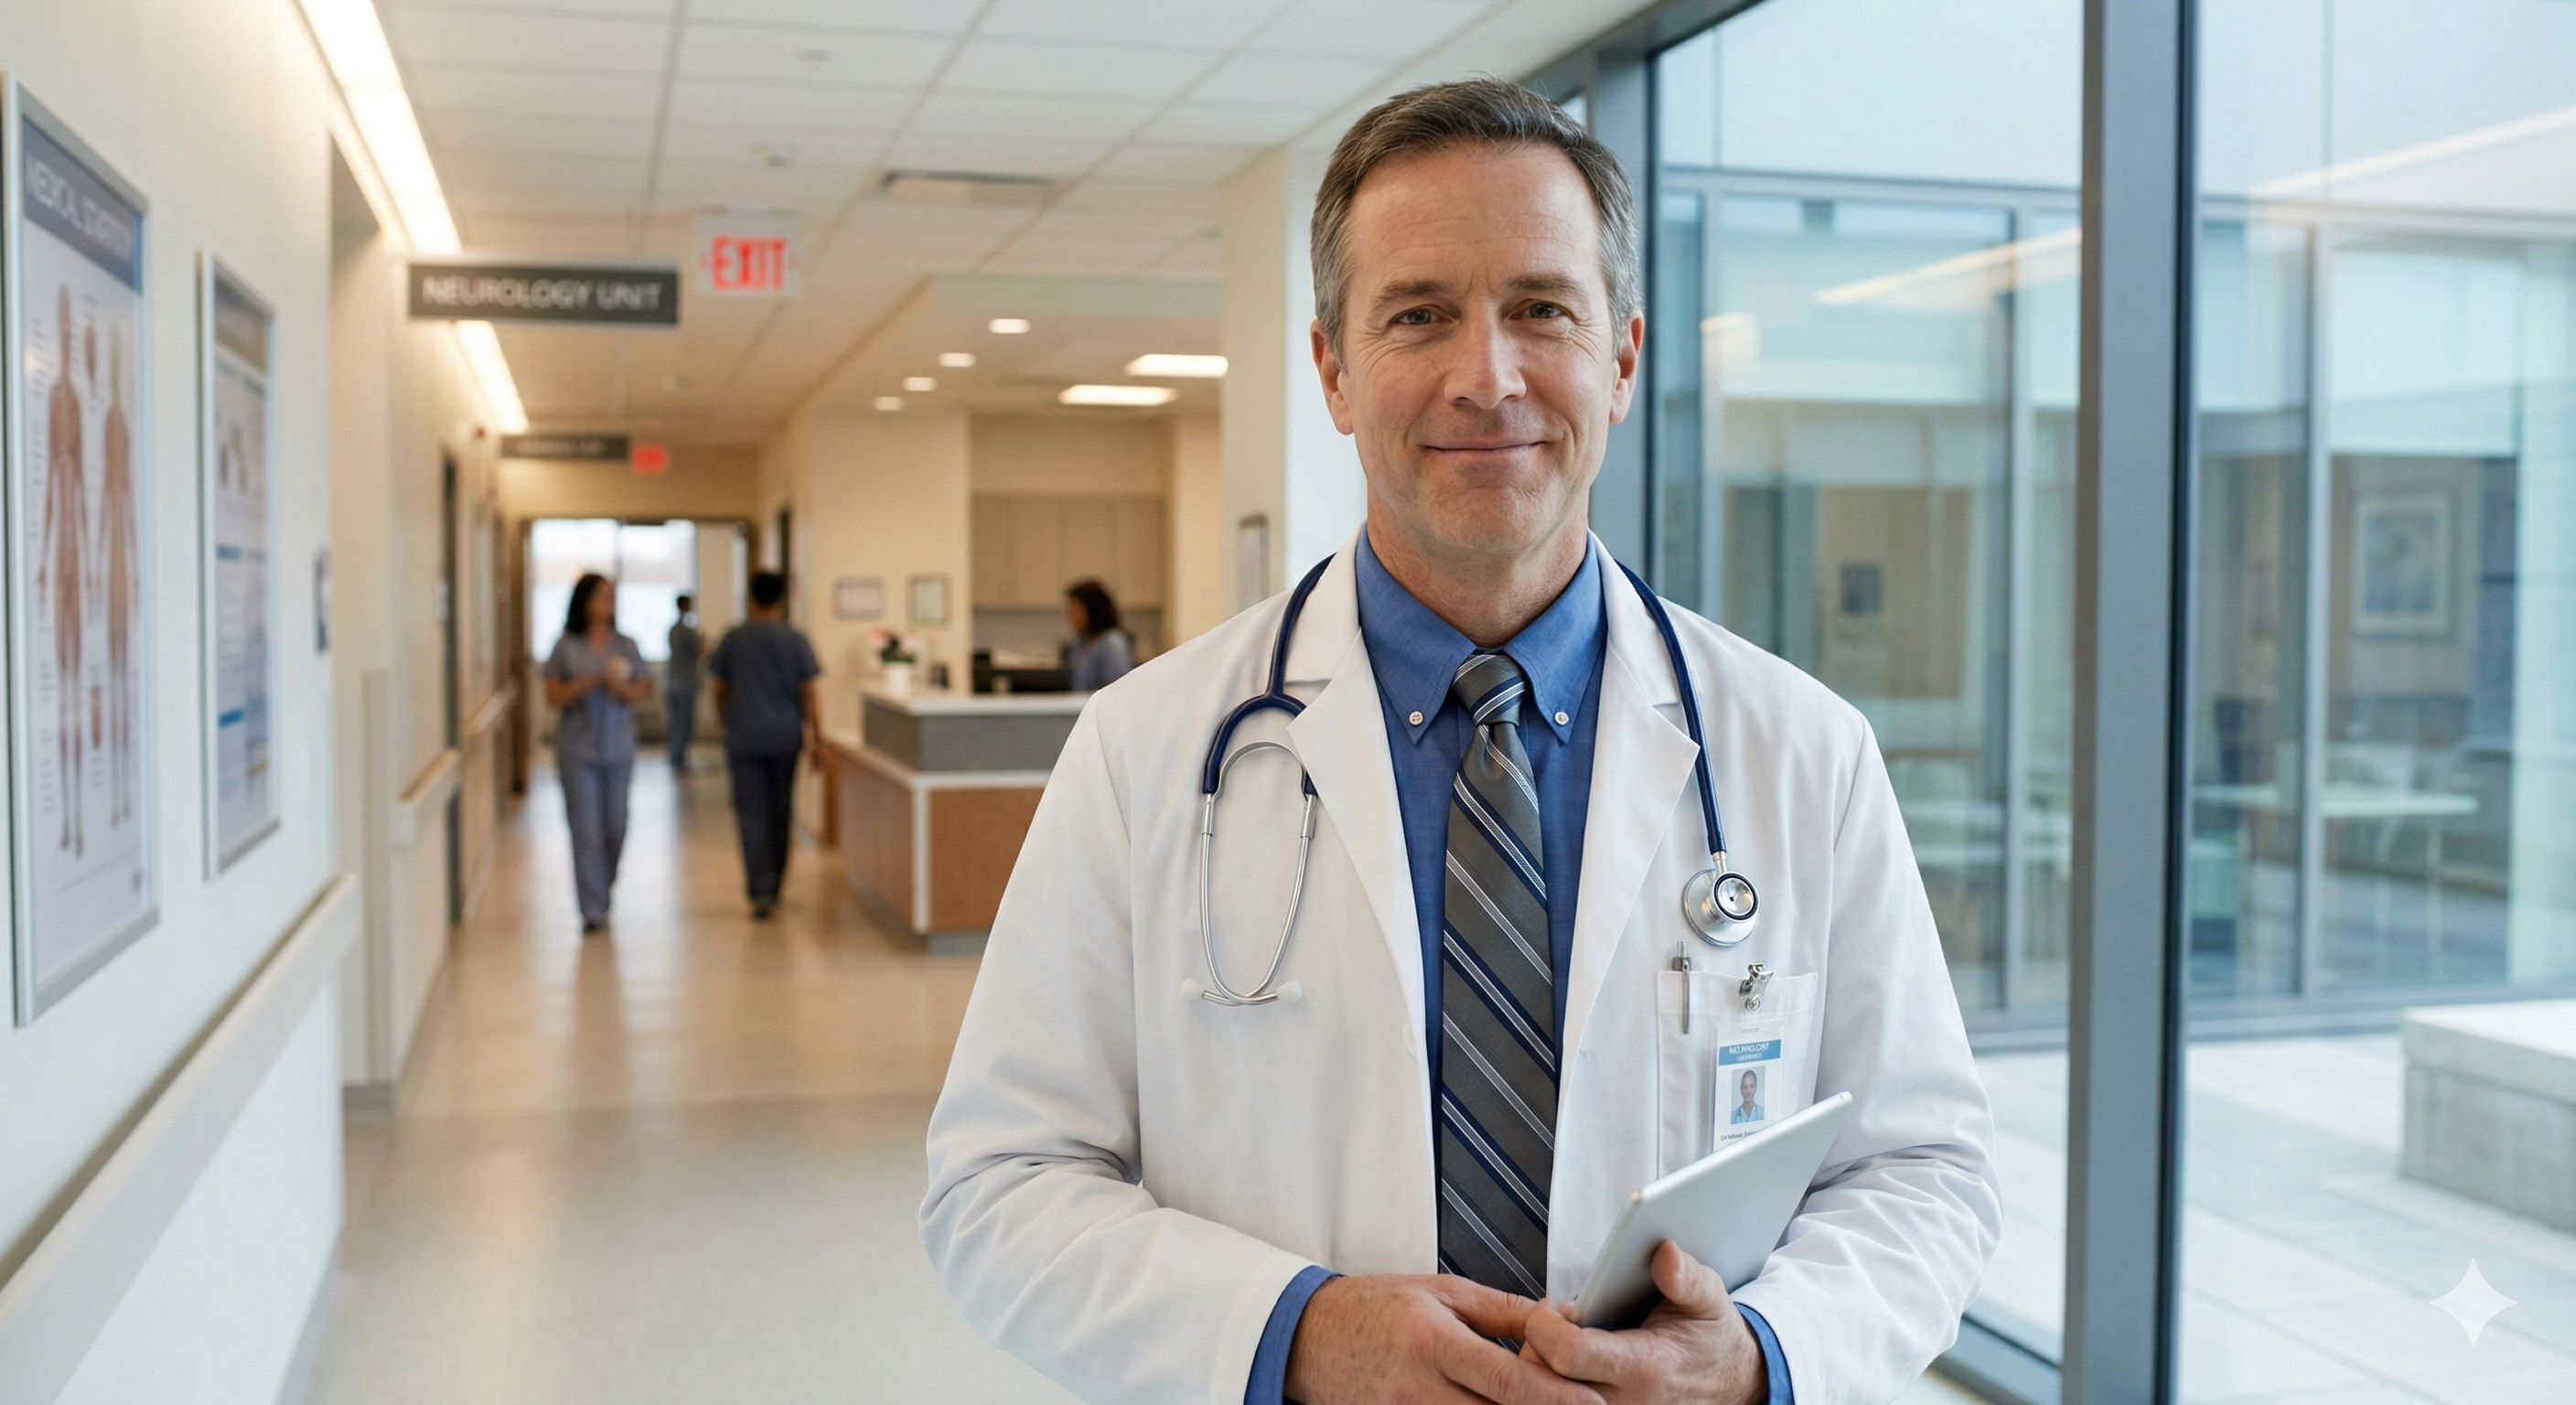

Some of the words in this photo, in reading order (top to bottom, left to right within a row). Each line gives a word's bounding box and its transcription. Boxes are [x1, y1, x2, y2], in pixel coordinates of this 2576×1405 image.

[712, 235, 788, 292] EXIT
[423, 276, 593, 309] NEUROLOGY
[596, 280, 662, 311] UNIT
